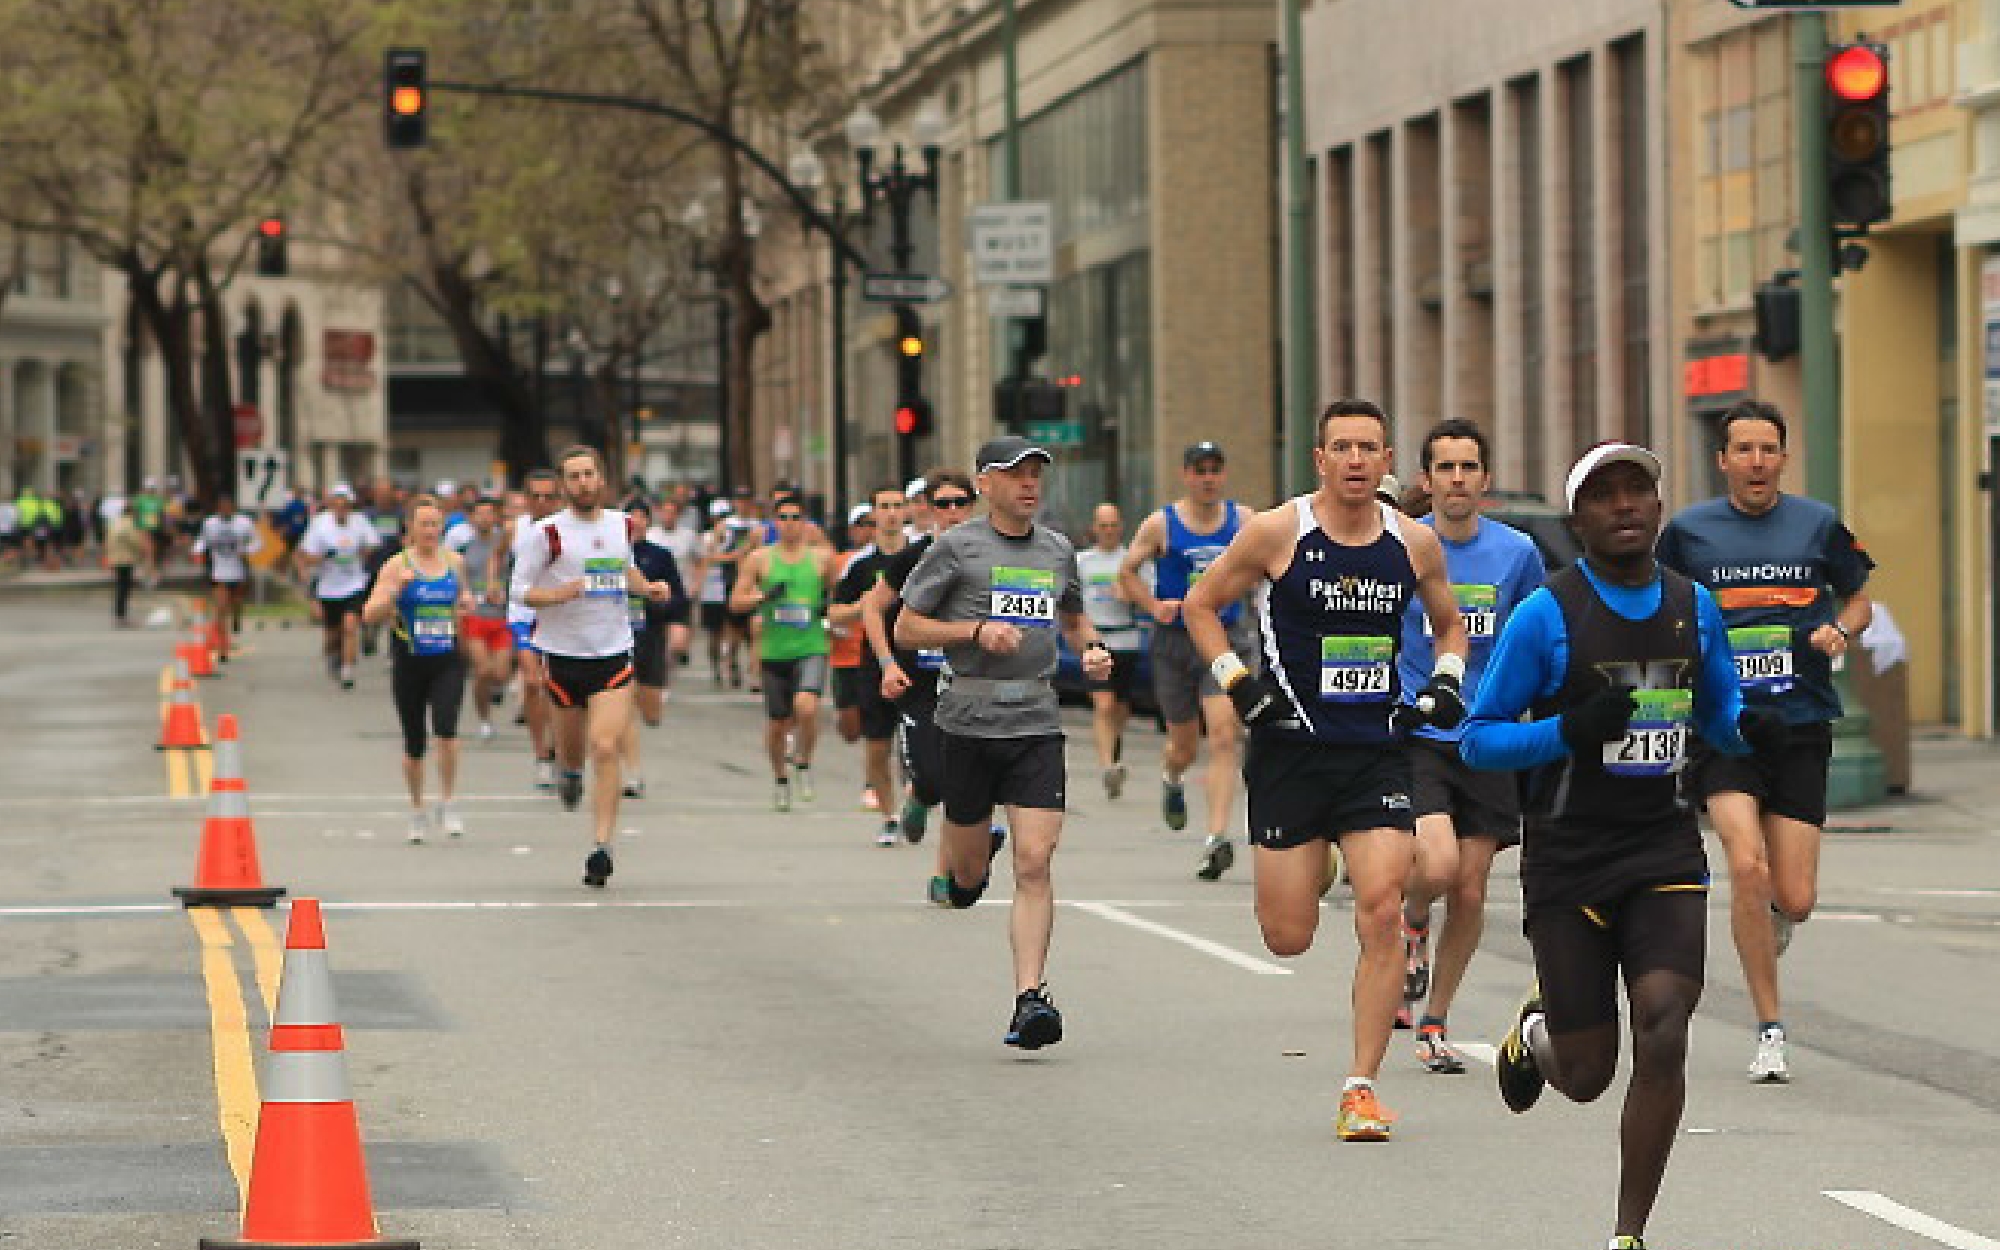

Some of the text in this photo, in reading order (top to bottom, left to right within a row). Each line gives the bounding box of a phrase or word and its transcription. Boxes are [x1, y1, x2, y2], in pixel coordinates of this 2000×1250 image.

[1310, 578, 1402, 601] Pac West
[1000, 595, 1048, 617] 2434
[1330, 670, 1384, 690] 4972
